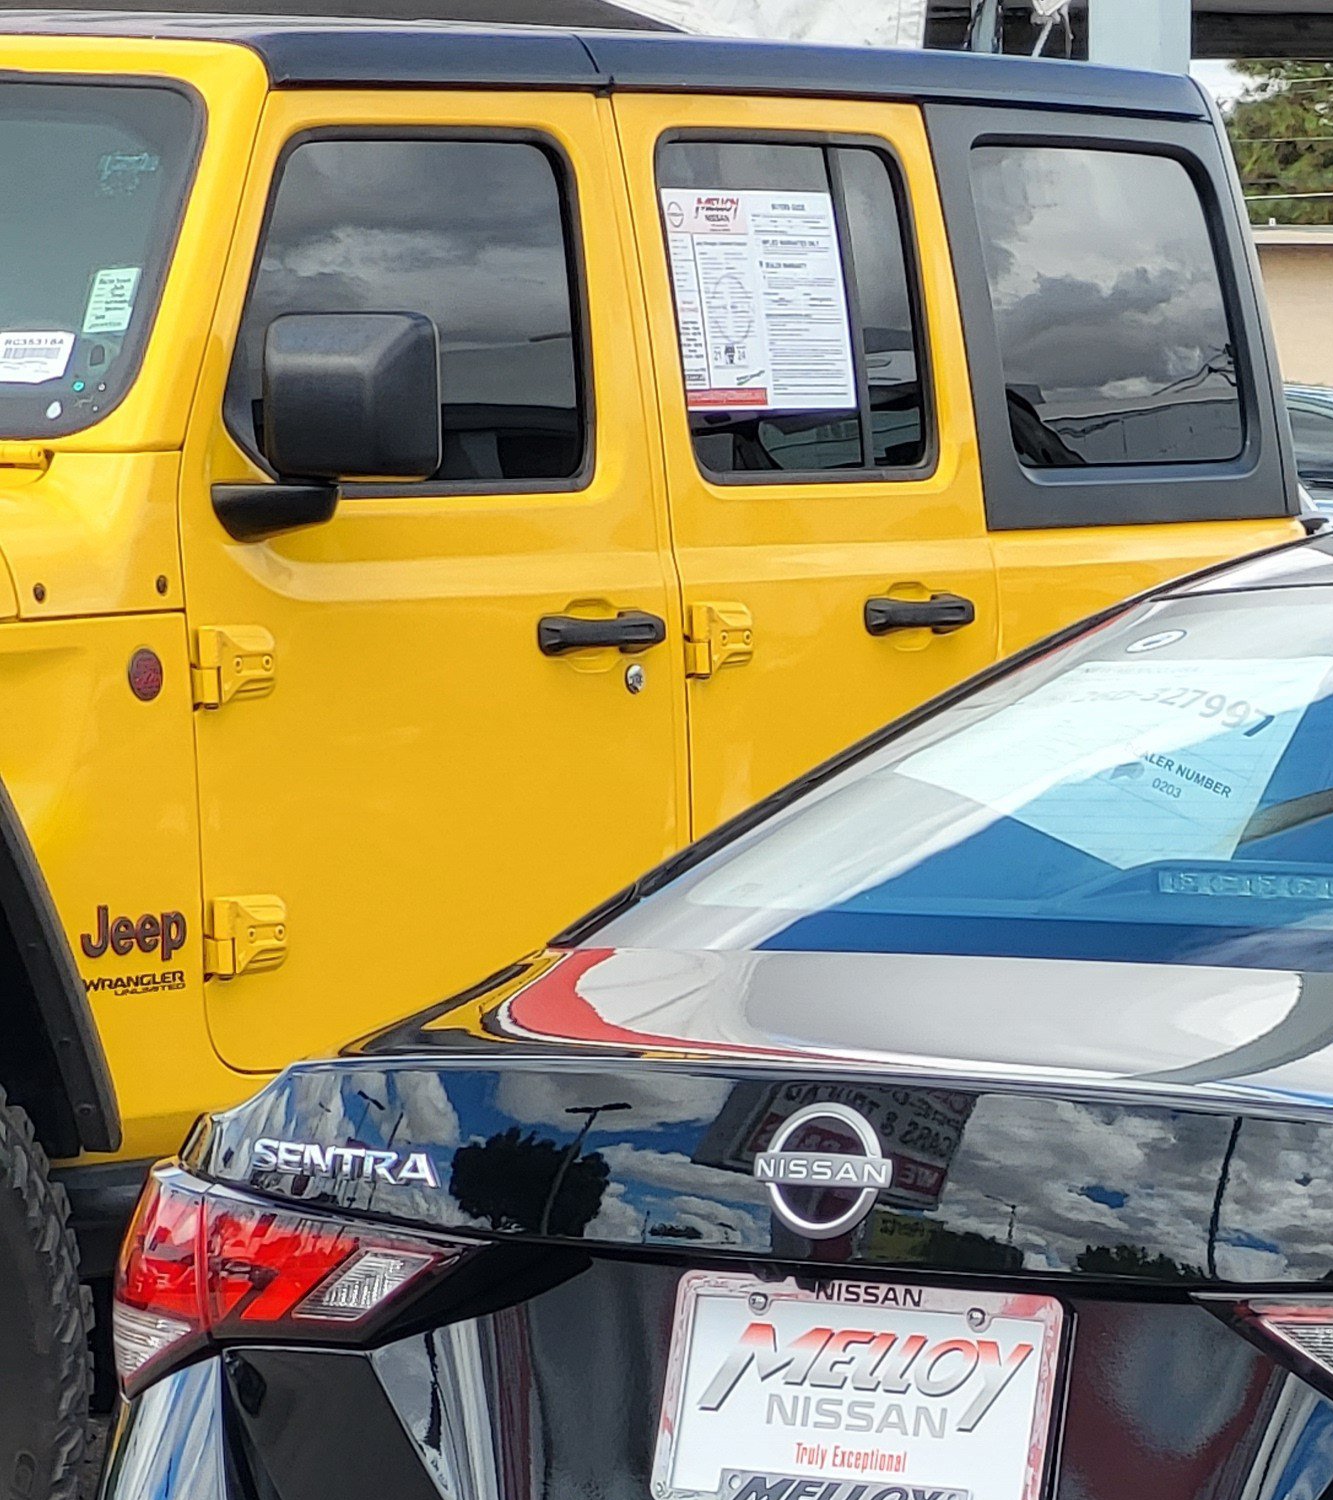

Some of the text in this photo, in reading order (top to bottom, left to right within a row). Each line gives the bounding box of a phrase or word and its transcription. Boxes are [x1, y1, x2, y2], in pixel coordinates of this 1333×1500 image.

[1151, 777, 1183, 799] 0203
[1175, 763, 1233, 799] NUMBER
[80, 904, 187, 962] Jeep
[82, 970, 185, 993] WRANGLER
[252, 1137, 442, 1188] SENTRA
[756, 1158, 888, 1185] NISSAN
[814, 1280, 923, 1308] NISSAN
[697, 1322, 1034, 1432] MELLOY
[765, 1393, 949, 1439] NISSAN
[794, 1442, 908, 1474] Truly Exceptional
